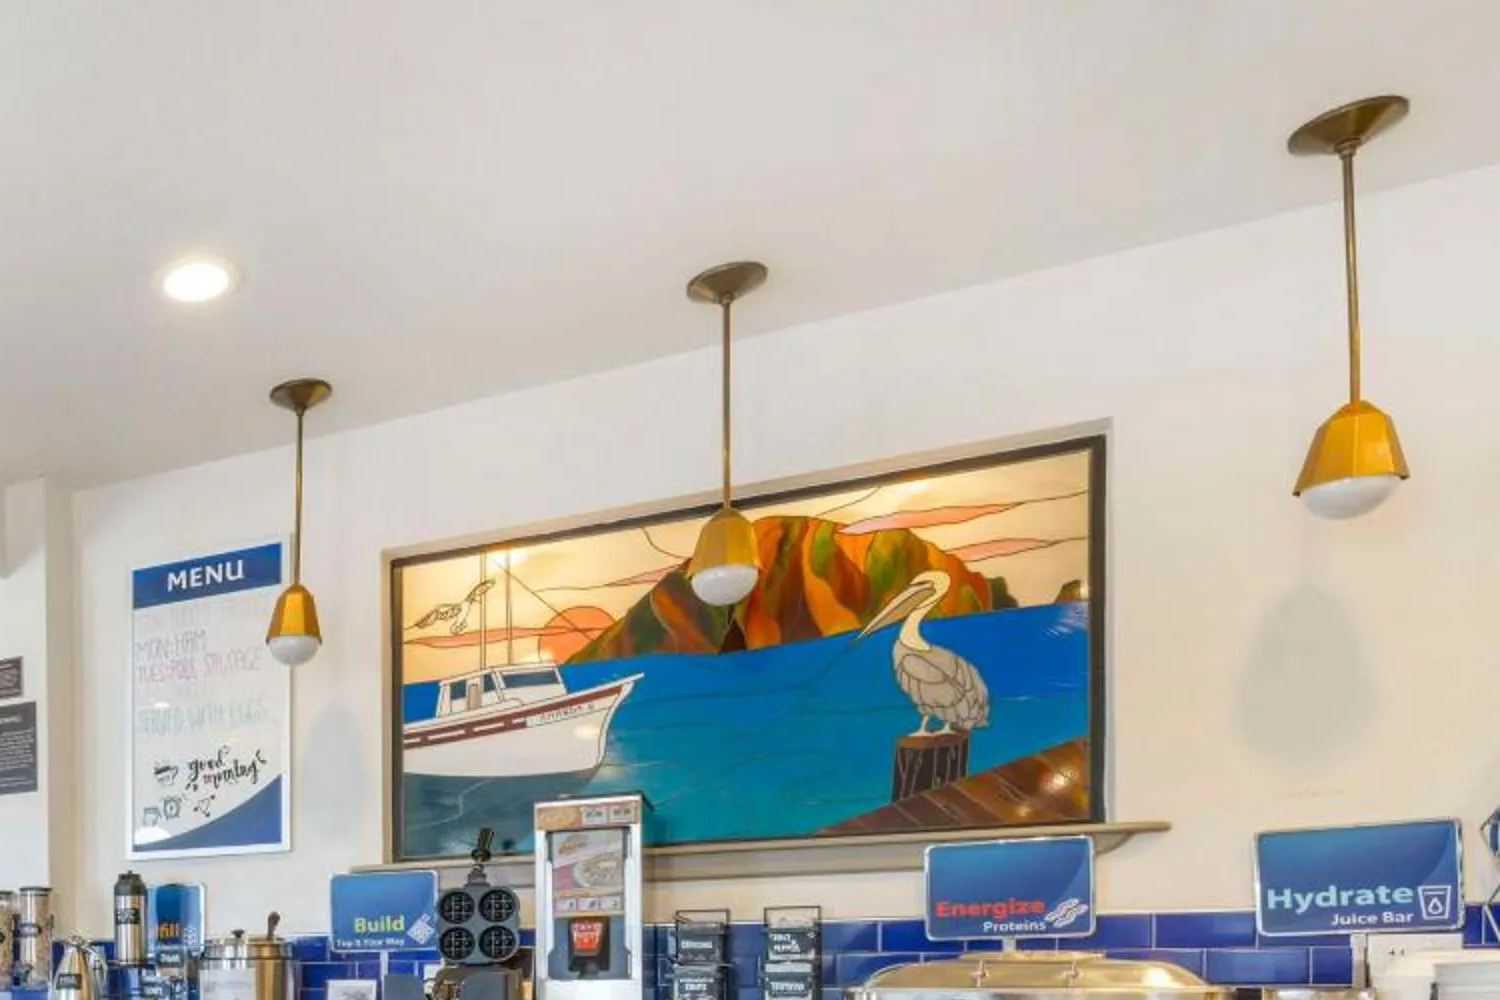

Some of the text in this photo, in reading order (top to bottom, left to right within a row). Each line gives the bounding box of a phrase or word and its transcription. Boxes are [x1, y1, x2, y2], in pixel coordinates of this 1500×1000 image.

[167, 559, 245, 592] MENU
[935, 898, 1045, 920] Energize
[1266, 885, 1414, 914] Hydrate
[355, 914, 405, 933] Build
[983, 920, 1046, 933] Proteins
[1331, 911, 1415, 926] Juice Bar
